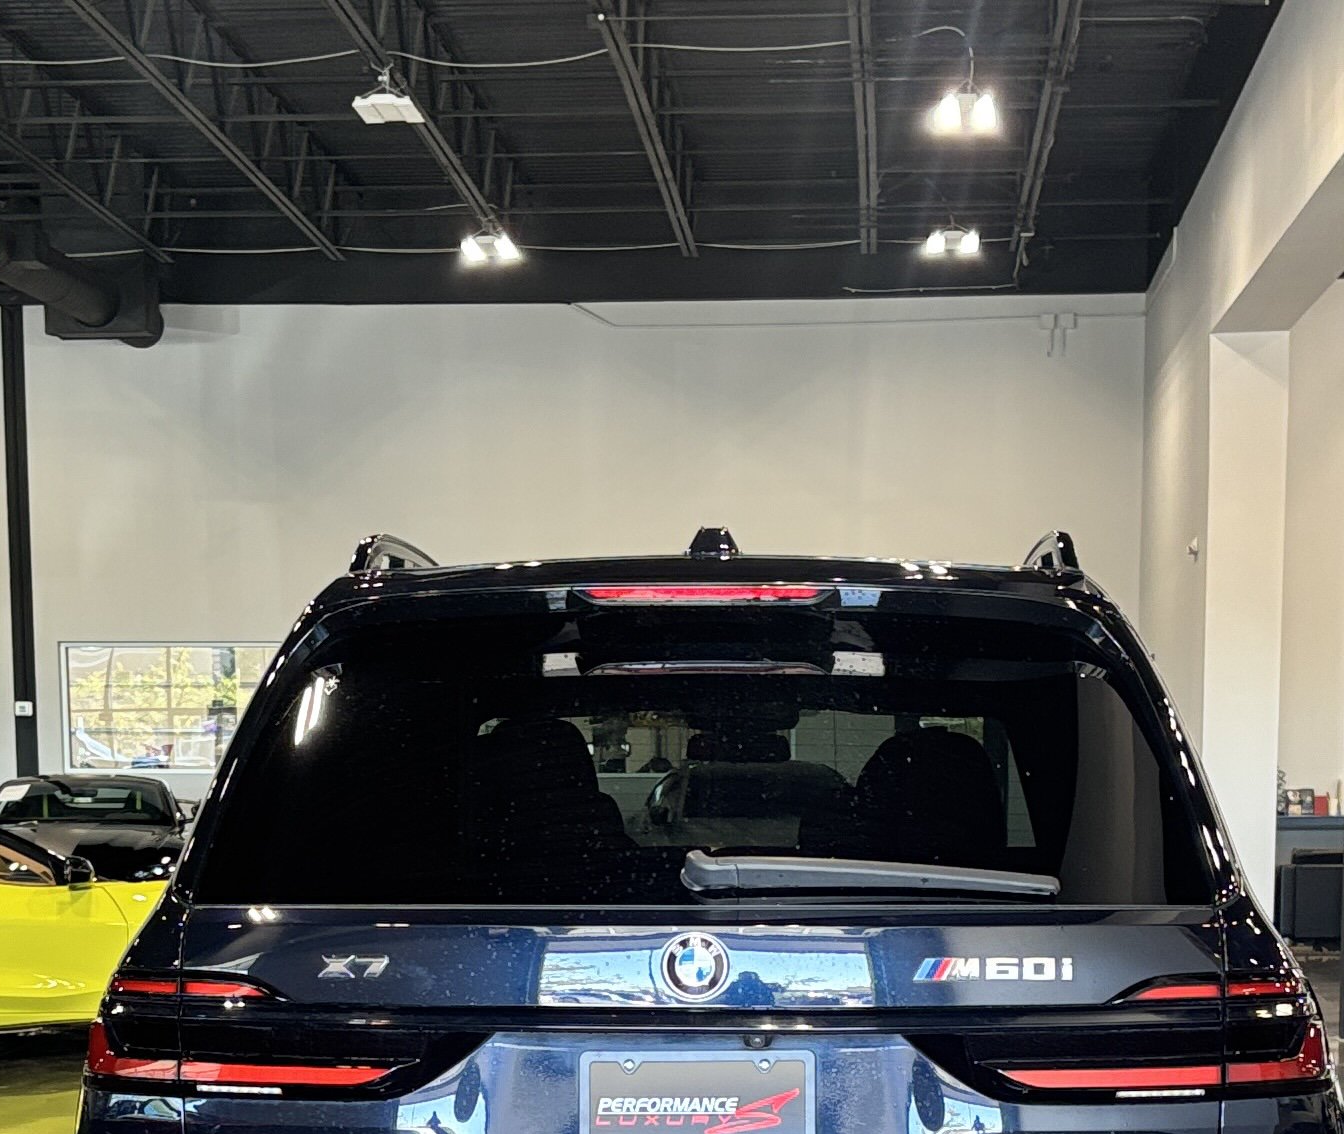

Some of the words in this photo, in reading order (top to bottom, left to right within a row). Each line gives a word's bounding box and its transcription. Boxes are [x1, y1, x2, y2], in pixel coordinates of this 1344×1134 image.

[671, 936, 722, 957] BMW
[317, 954, 390, 979] X7
[597, 1097, 739, 1114] PERFORMANCE
[595, 1115, 732, 1127] LUXURY
